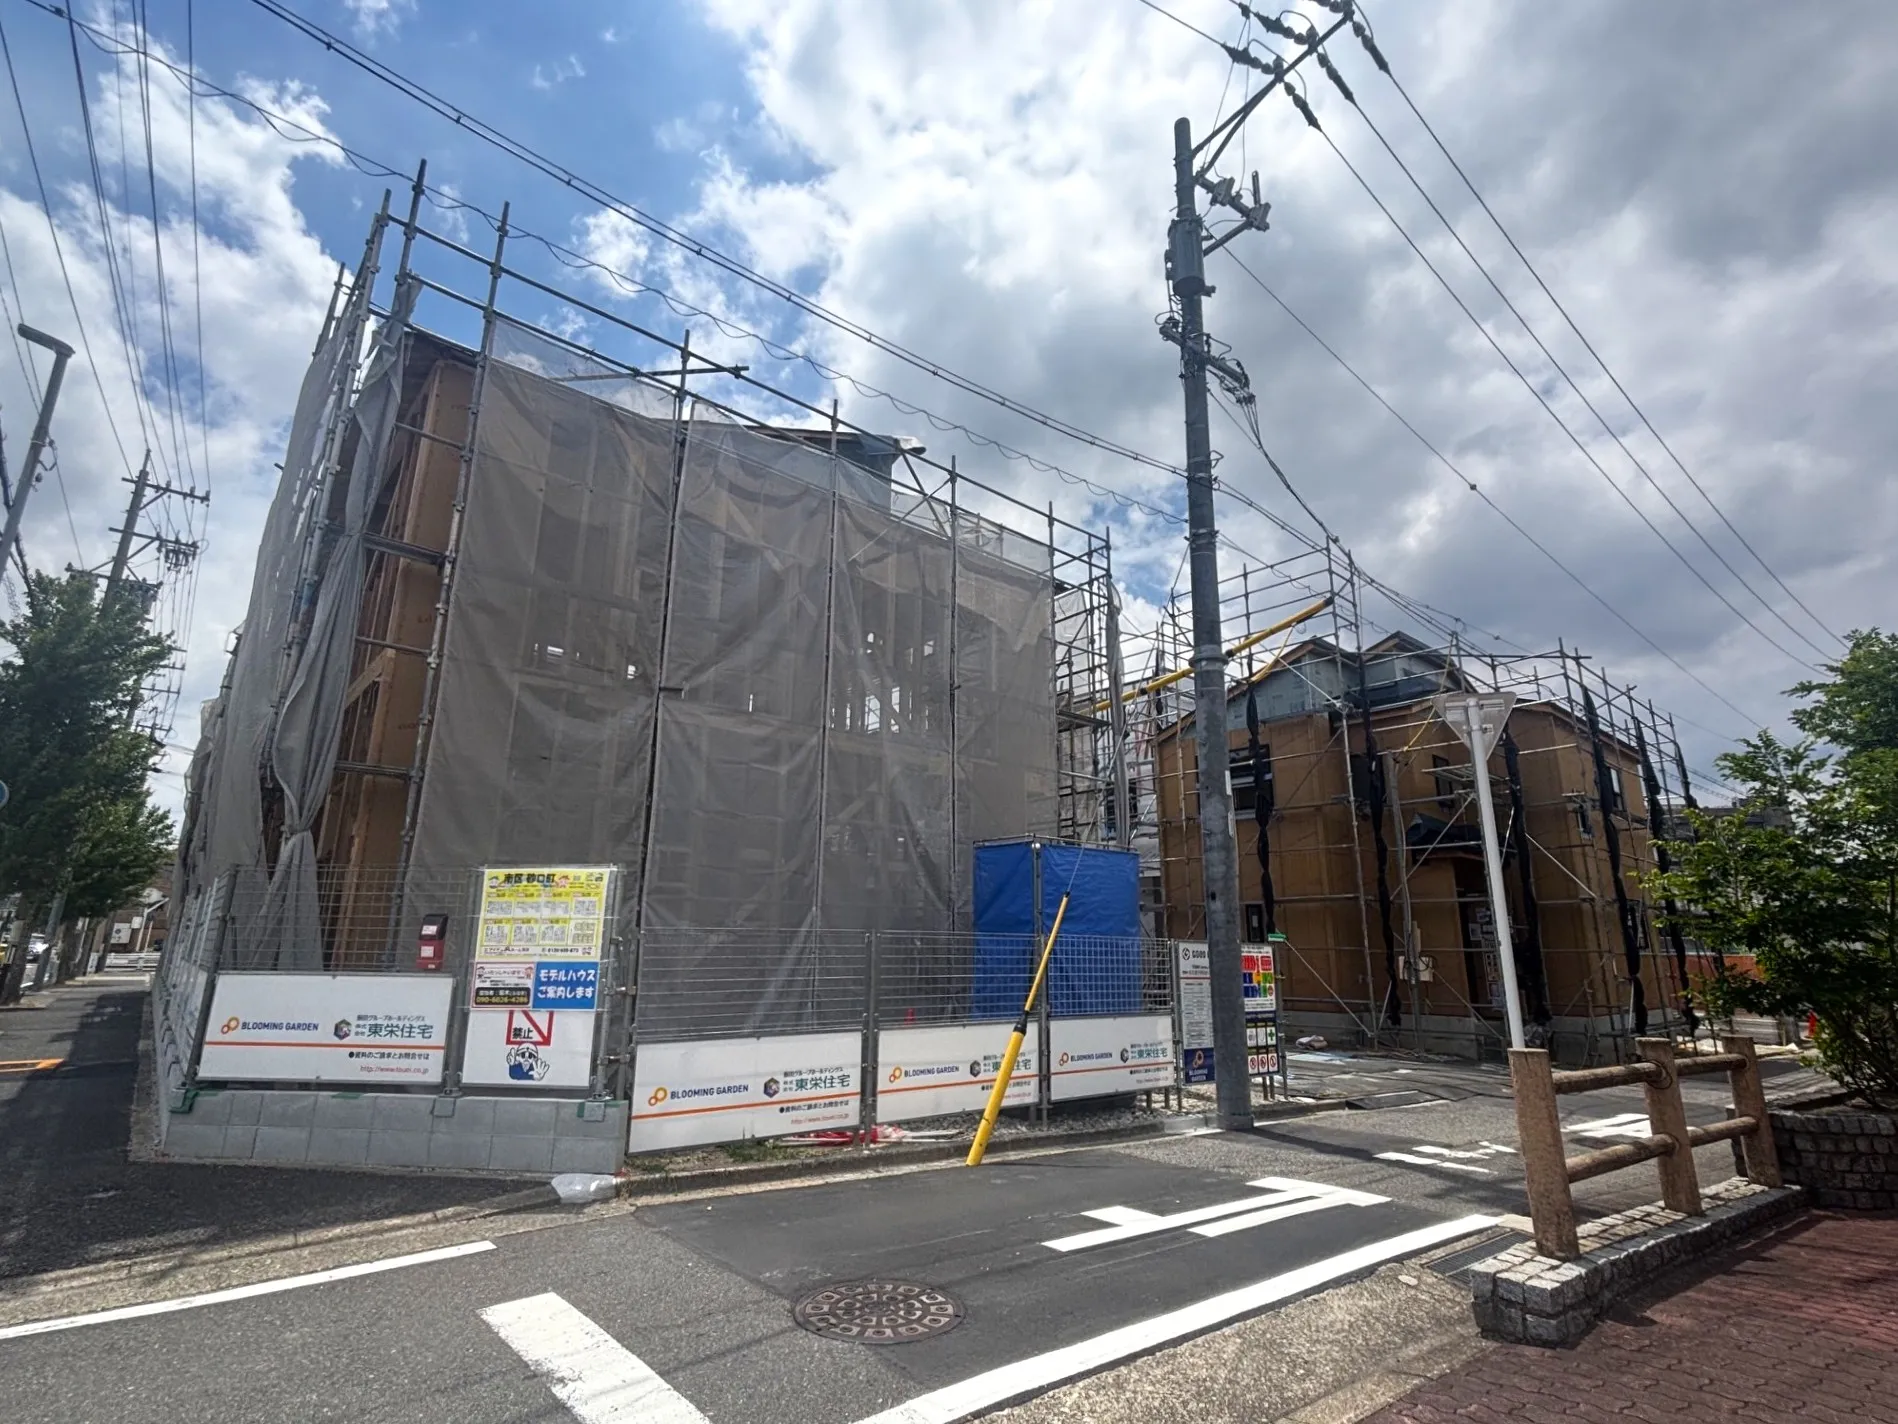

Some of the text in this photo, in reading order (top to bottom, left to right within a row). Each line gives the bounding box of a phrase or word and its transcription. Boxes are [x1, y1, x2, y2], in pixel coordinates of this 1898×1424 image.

[539, 969, 595, 981] モデルハウス
[537, 986, 594, 999] ご案内します
[241, 1021, 319, 1031] BLOOMING GARDEN
[367, 1023, 433, 1039] 東栄住宅
[512, 1027, 533, 1040] 禁止
[1070, 1052, 1113, 1062] BLOOMING GARDEN
[904, 1065, 959, 1078] BLOOMING GARDEN
[795, 1074, 851, 1091] 東栄住宅
[670, 1084, 749, 1099] BLOOMING GARDEN
